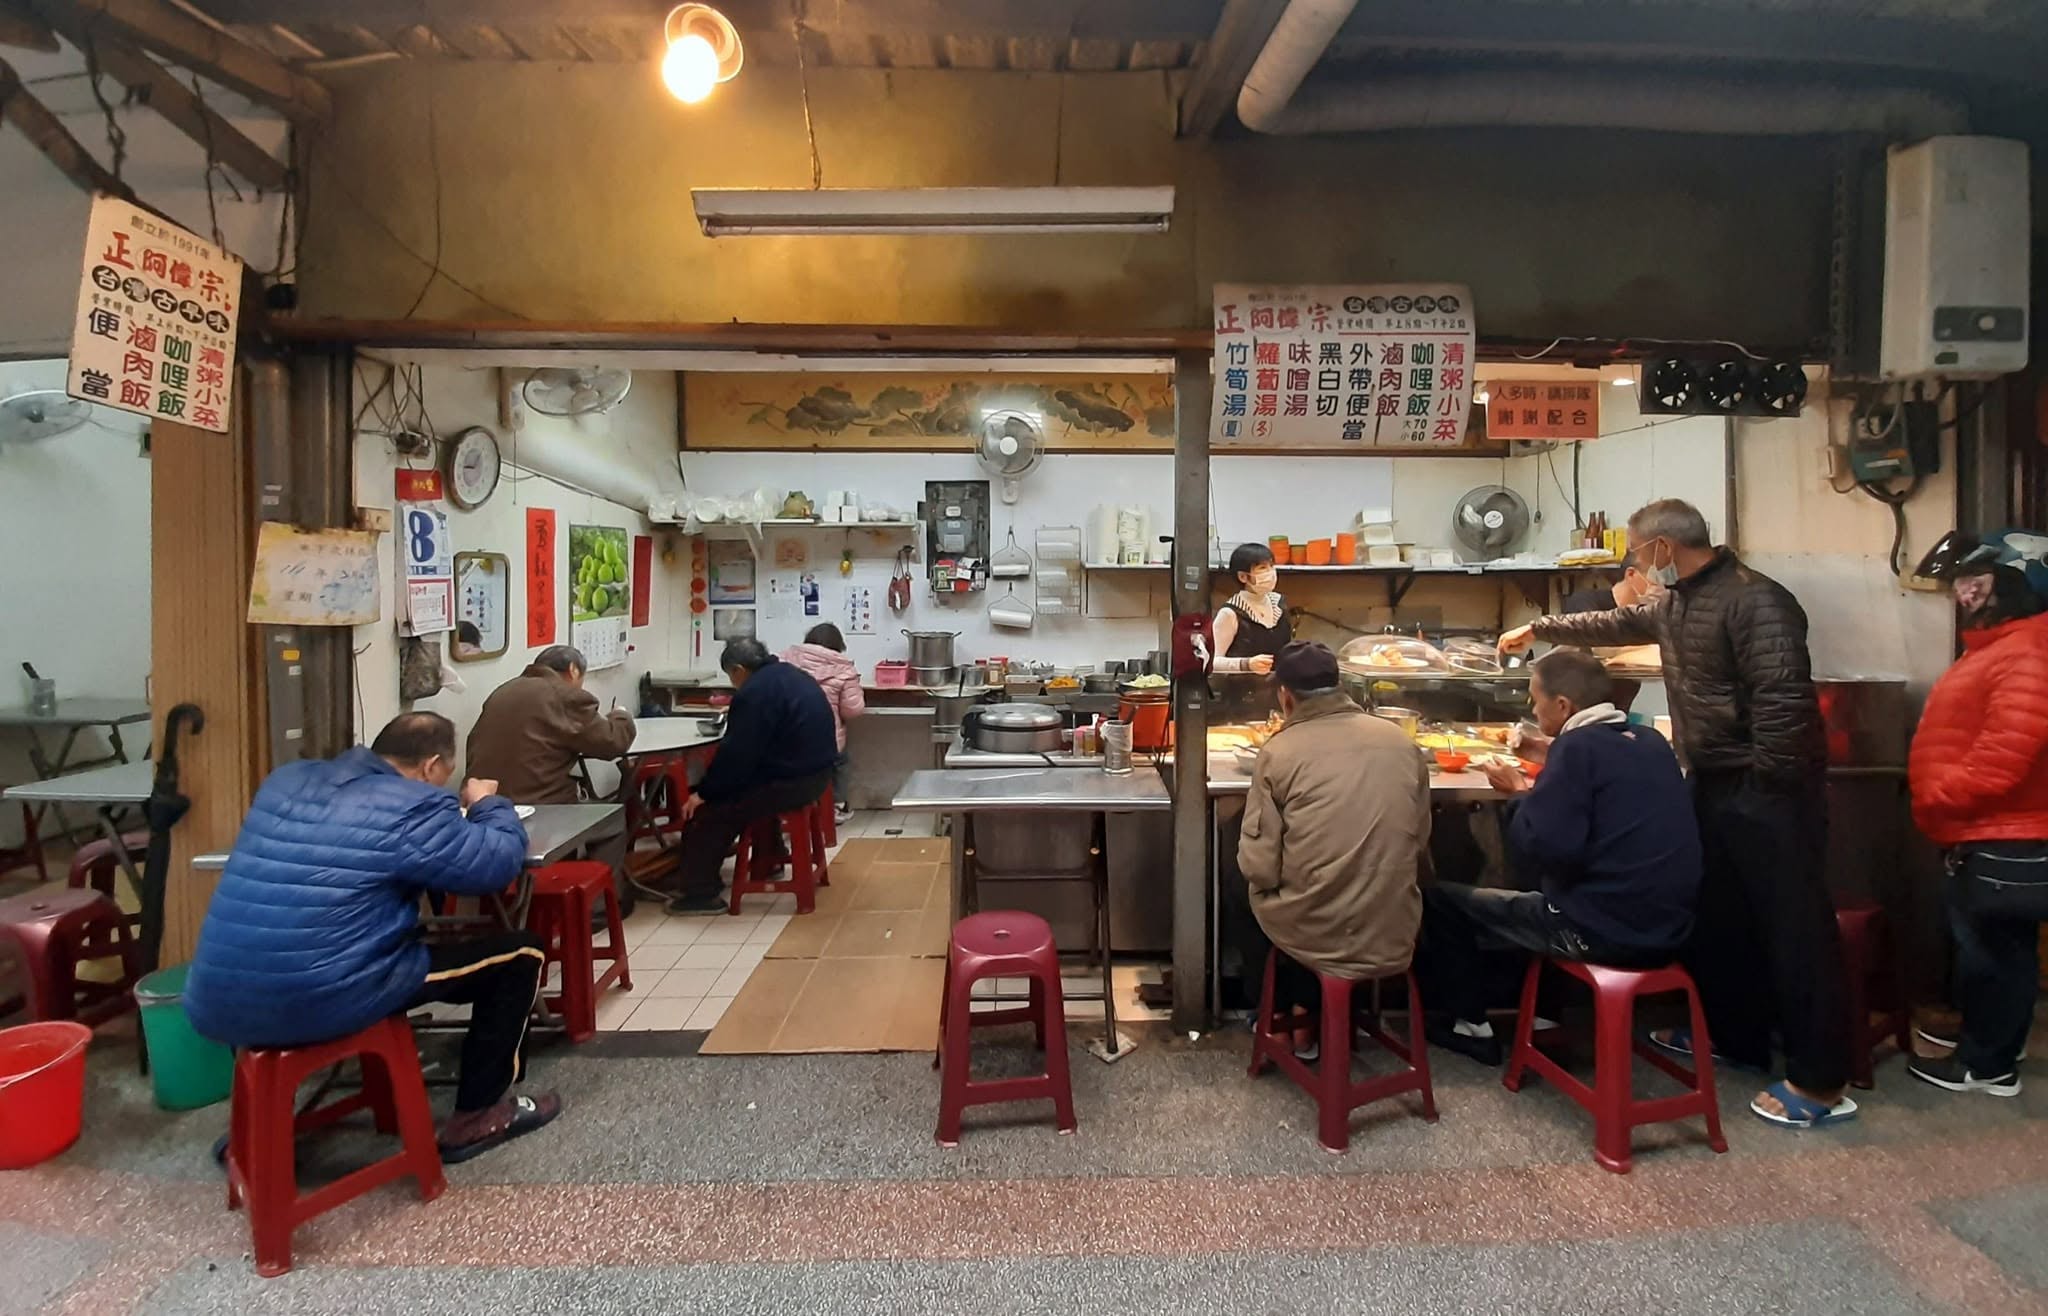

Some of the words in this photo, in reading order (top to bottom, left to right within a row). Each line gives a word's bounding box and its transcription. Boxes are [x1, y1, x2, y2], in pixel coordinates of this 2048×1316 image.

[92, 264, 230, 334] 台灣古早味
[120, 319, 159, 410] 滷肉飯
[157, 334, 193, 419] 咖哩飯
[192, 345, 226, 428] 清粥小菜
[1316, 342, 1342, 416] 黑白切
[1342, 342, 1373, 440] 外帶便當
[1375, 342, 1404, 416] 滷肉飯
[1405, 342, 1434, 416] 咖哩飯
[1432, 342, 1465, 440] 清粥小菜
[408, 510, 435, 563] 8
